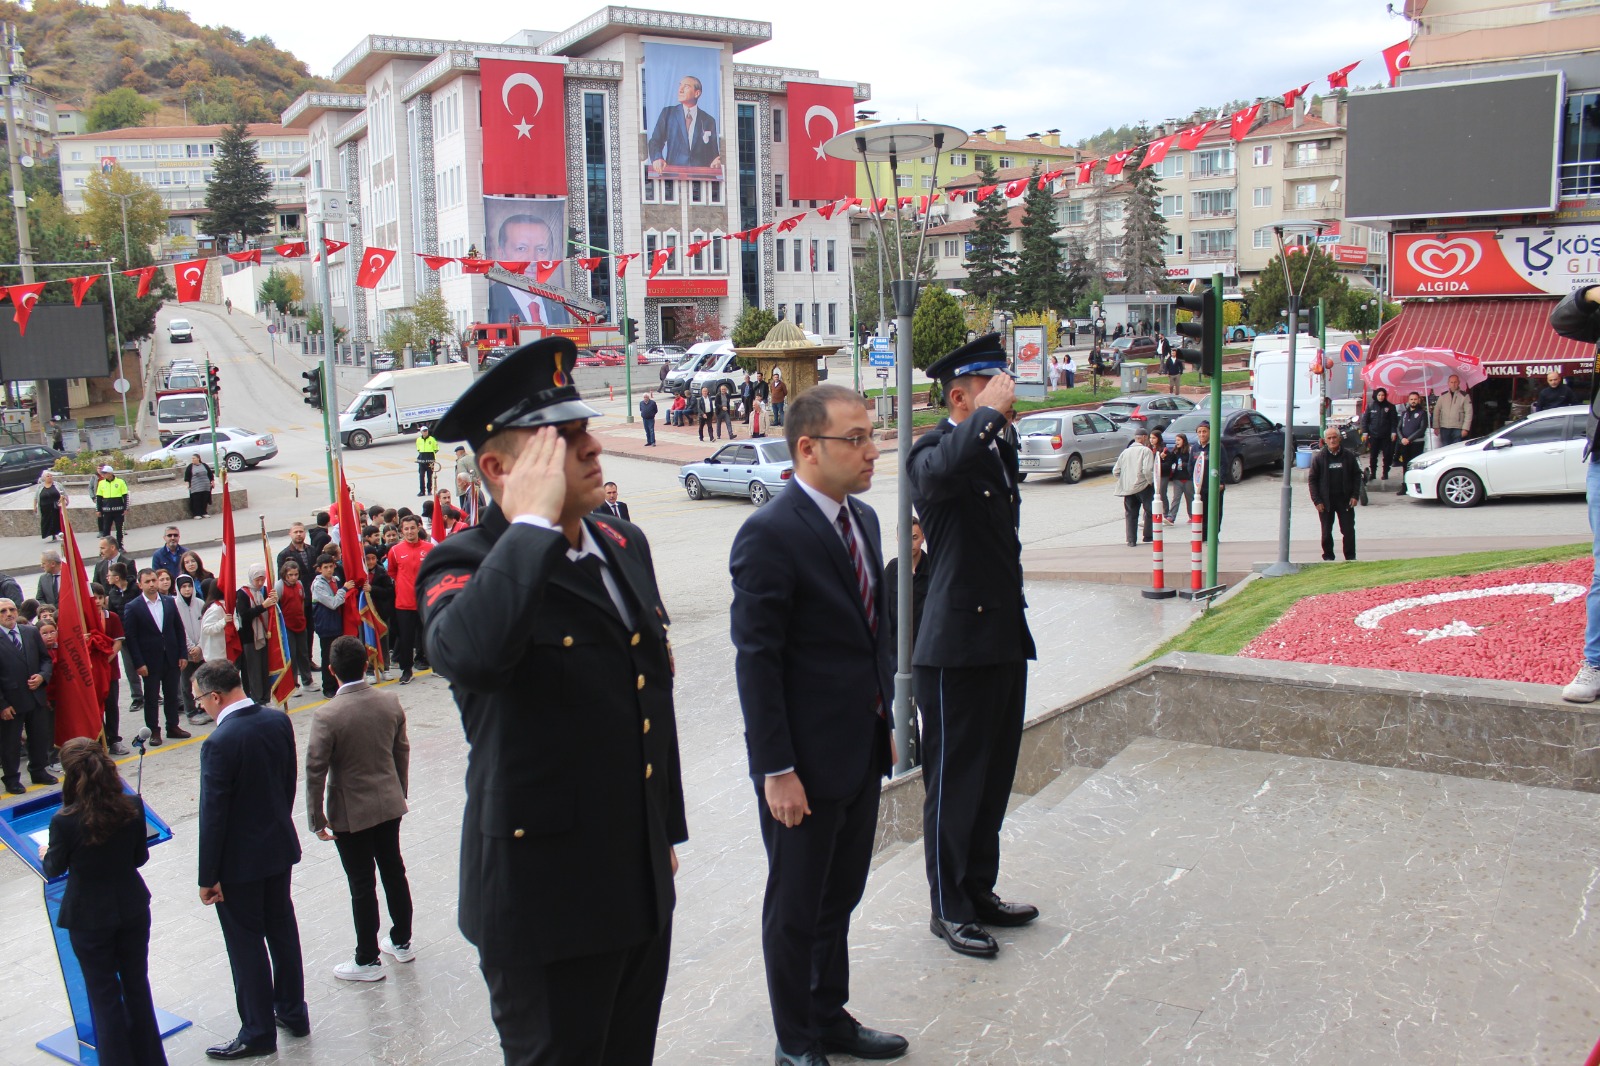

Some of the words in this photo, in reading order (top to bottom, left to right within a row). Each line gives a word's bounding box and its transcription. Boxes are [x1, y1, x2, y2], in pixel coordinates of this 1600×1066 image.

[1567, 258, 1600, 273] GI
[1416, 281, 1470, 292] ALGIDA
[1486, 366, 1520, 376] AKKAL
[1525, 365, 1562, 378] ŞADAN
